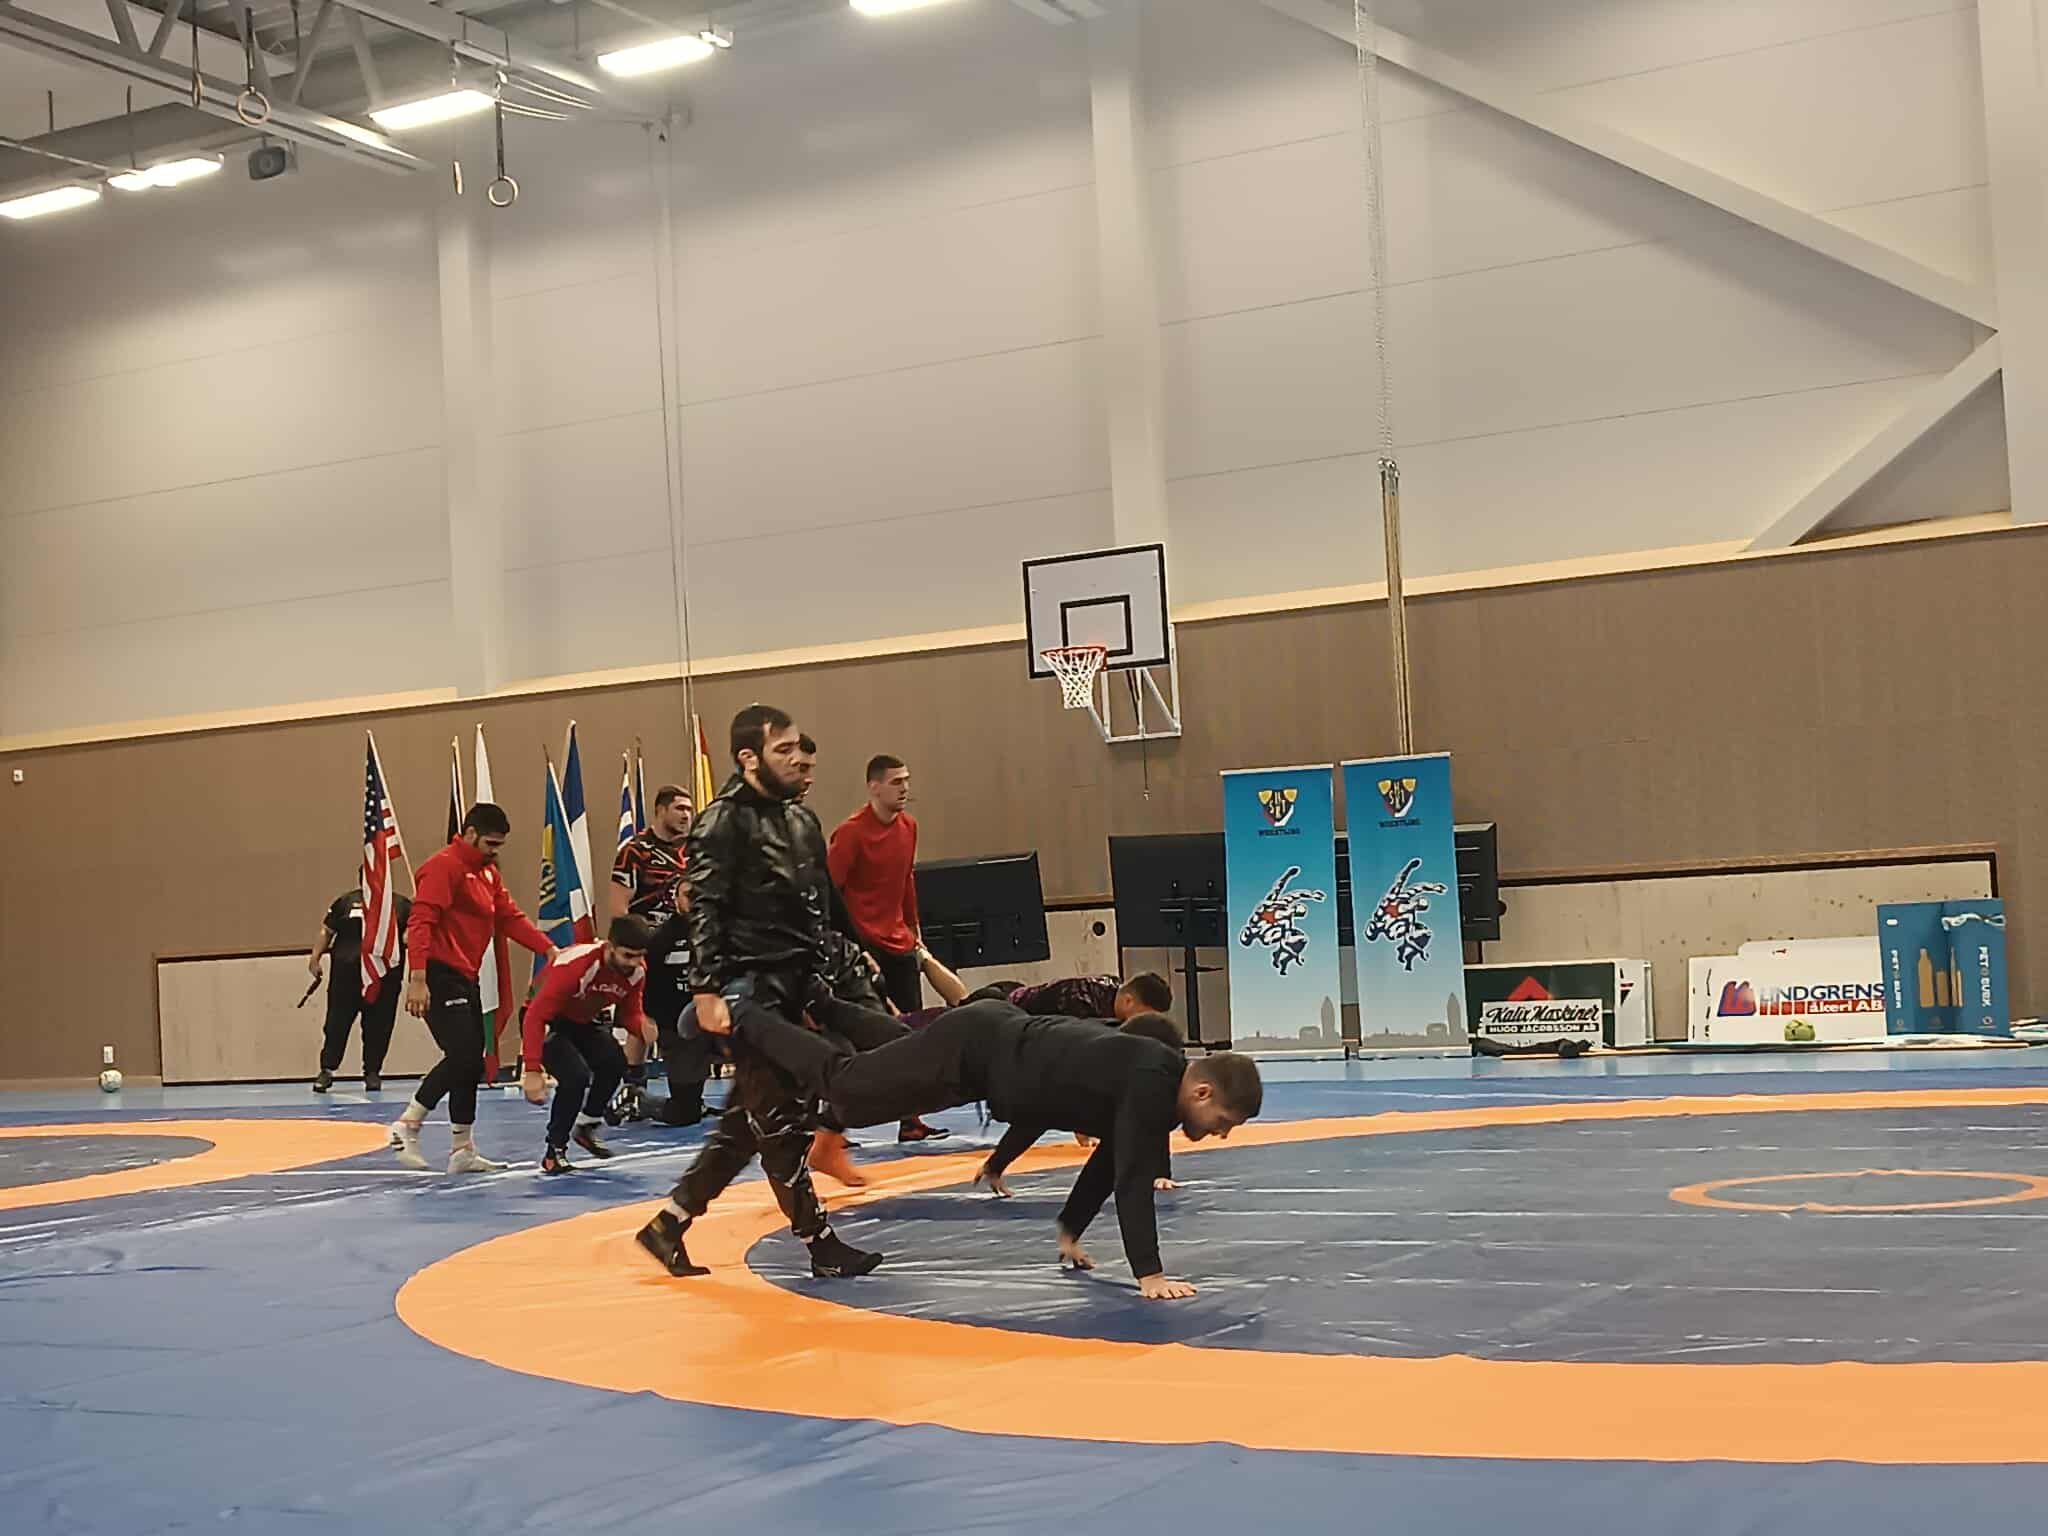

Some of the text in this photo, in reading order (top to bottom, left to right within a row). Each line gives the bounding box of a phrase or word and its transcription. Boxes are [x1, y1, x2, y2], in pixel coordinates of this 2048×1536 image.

[1760, 983, 1885, 1003] LINDGRENS
[1486, 1004, 1600, 1023] Kalix Maskiner
[1855, 1000, 1884, 1012] AB
[1520, 1024, 1580, 1033] JACOBSSON
